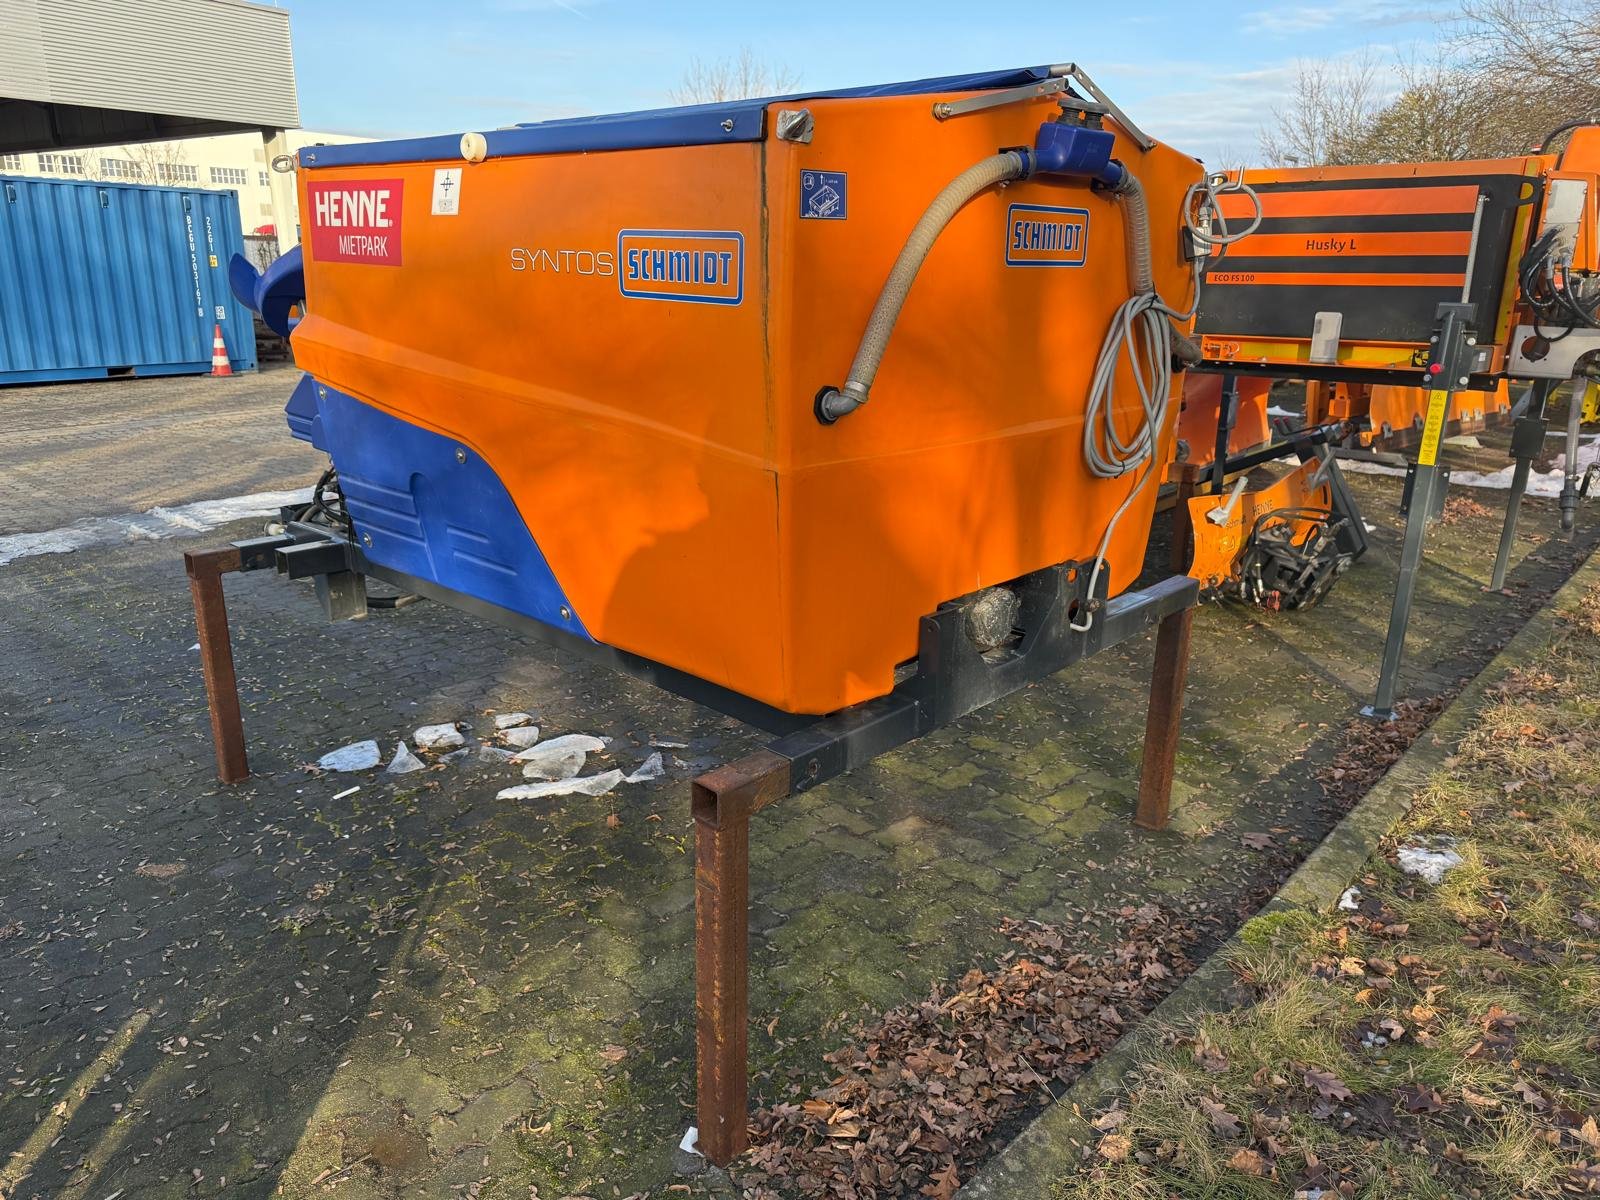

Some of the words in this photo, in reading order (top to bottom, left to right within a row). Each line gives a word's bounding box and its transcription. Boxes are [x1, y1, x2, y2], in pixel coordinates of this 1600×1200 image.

[205, 216, 214, 252] 22G1
[338, 234, 389, 257] MIETPARK
[1013, 220, 1083, 252] SCHMIDT
[1306, 238, 1346, 253] Husky
[1350, 238, 1357, 250] L
[186, 215, 196, 252] BCGU
[191, 253, 202, 306] 503167
[511, 248, 614, 277] SYNTOS
[627, 248, 733, 286] SCHMIDT
[1214, 273, 1230, 282] ECO
[1231, 273, 1240, 282] FS
[1241, 273, 1255, 282] 100
